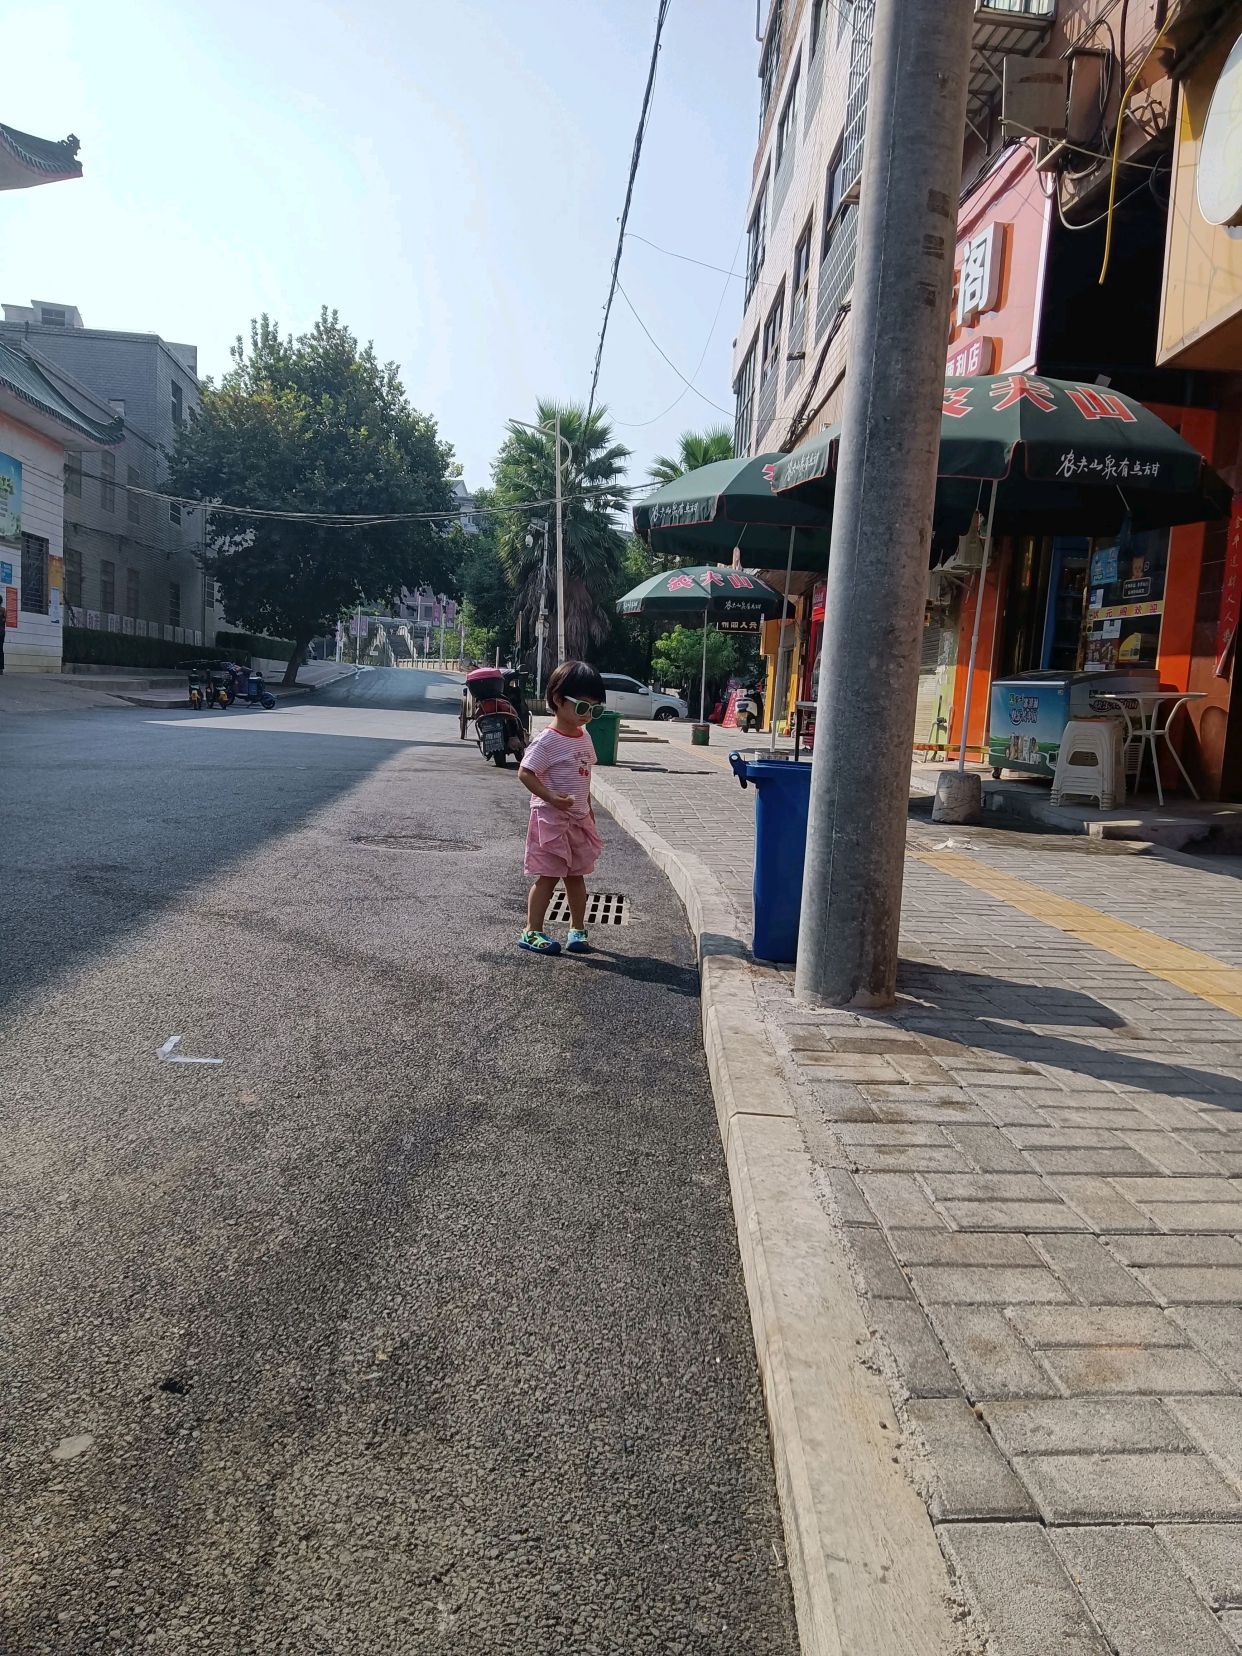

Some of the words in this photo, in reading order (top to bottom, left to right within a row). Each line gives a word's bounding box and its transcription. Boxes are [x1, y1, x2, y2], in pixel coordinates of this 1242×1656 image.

[1056, 449, 1161, 480] 农夫山泉有点甜
